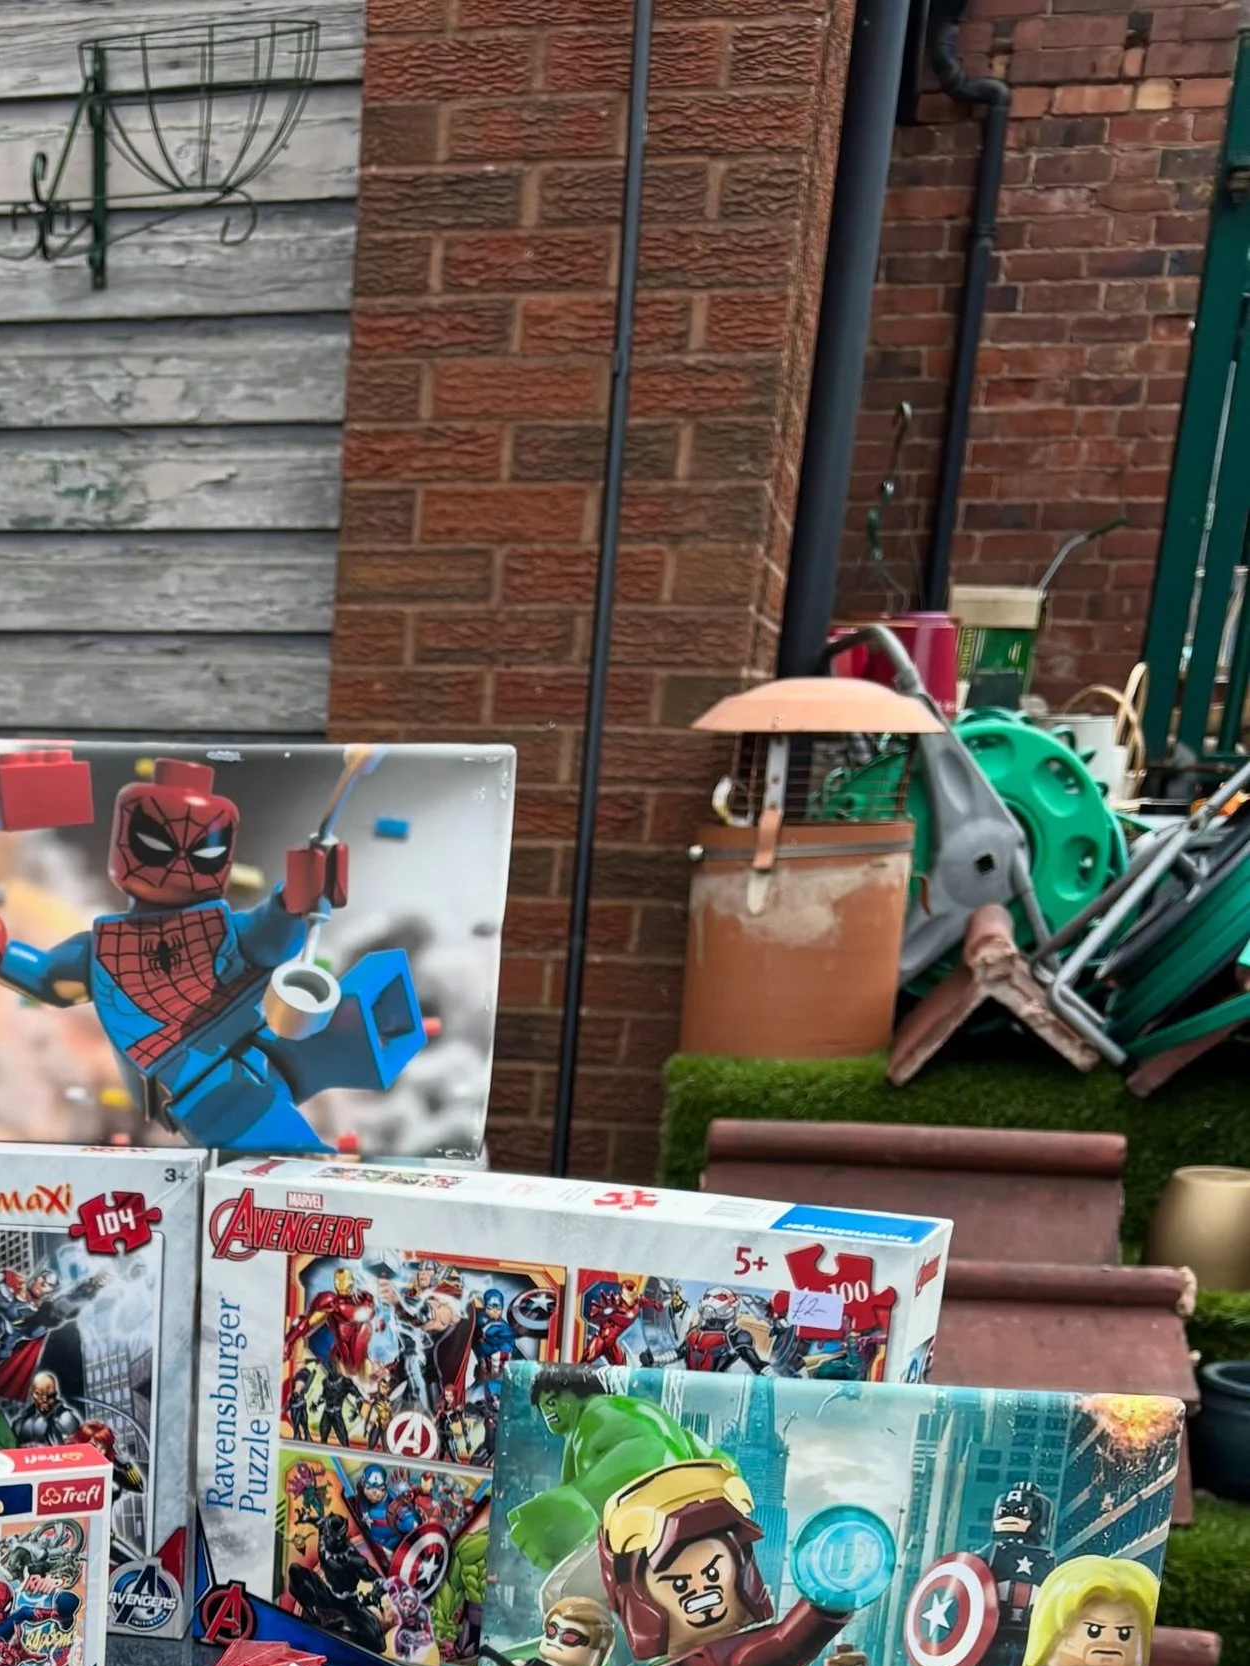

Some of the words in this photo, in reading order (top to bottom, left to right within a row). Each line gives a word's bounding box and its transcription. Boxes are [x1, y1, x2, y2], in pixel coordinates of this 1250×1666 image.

[164, 1168, 188, 1182] 3+
[288, 1192, 323, 1210] MARVEL
[96, 1208, 137, 1236] 104
[210, 1188, 372, 1261] AVENGERS
[734, 1246, 769, 1276] 5+
[206, 1297, 249, 1510] Ravensburger
[239, 1418, 272, 1516] Puzzle
[62, 1482, 101, 1505] Trefl
[108, 1591, 178, 1611] AVENGERS
